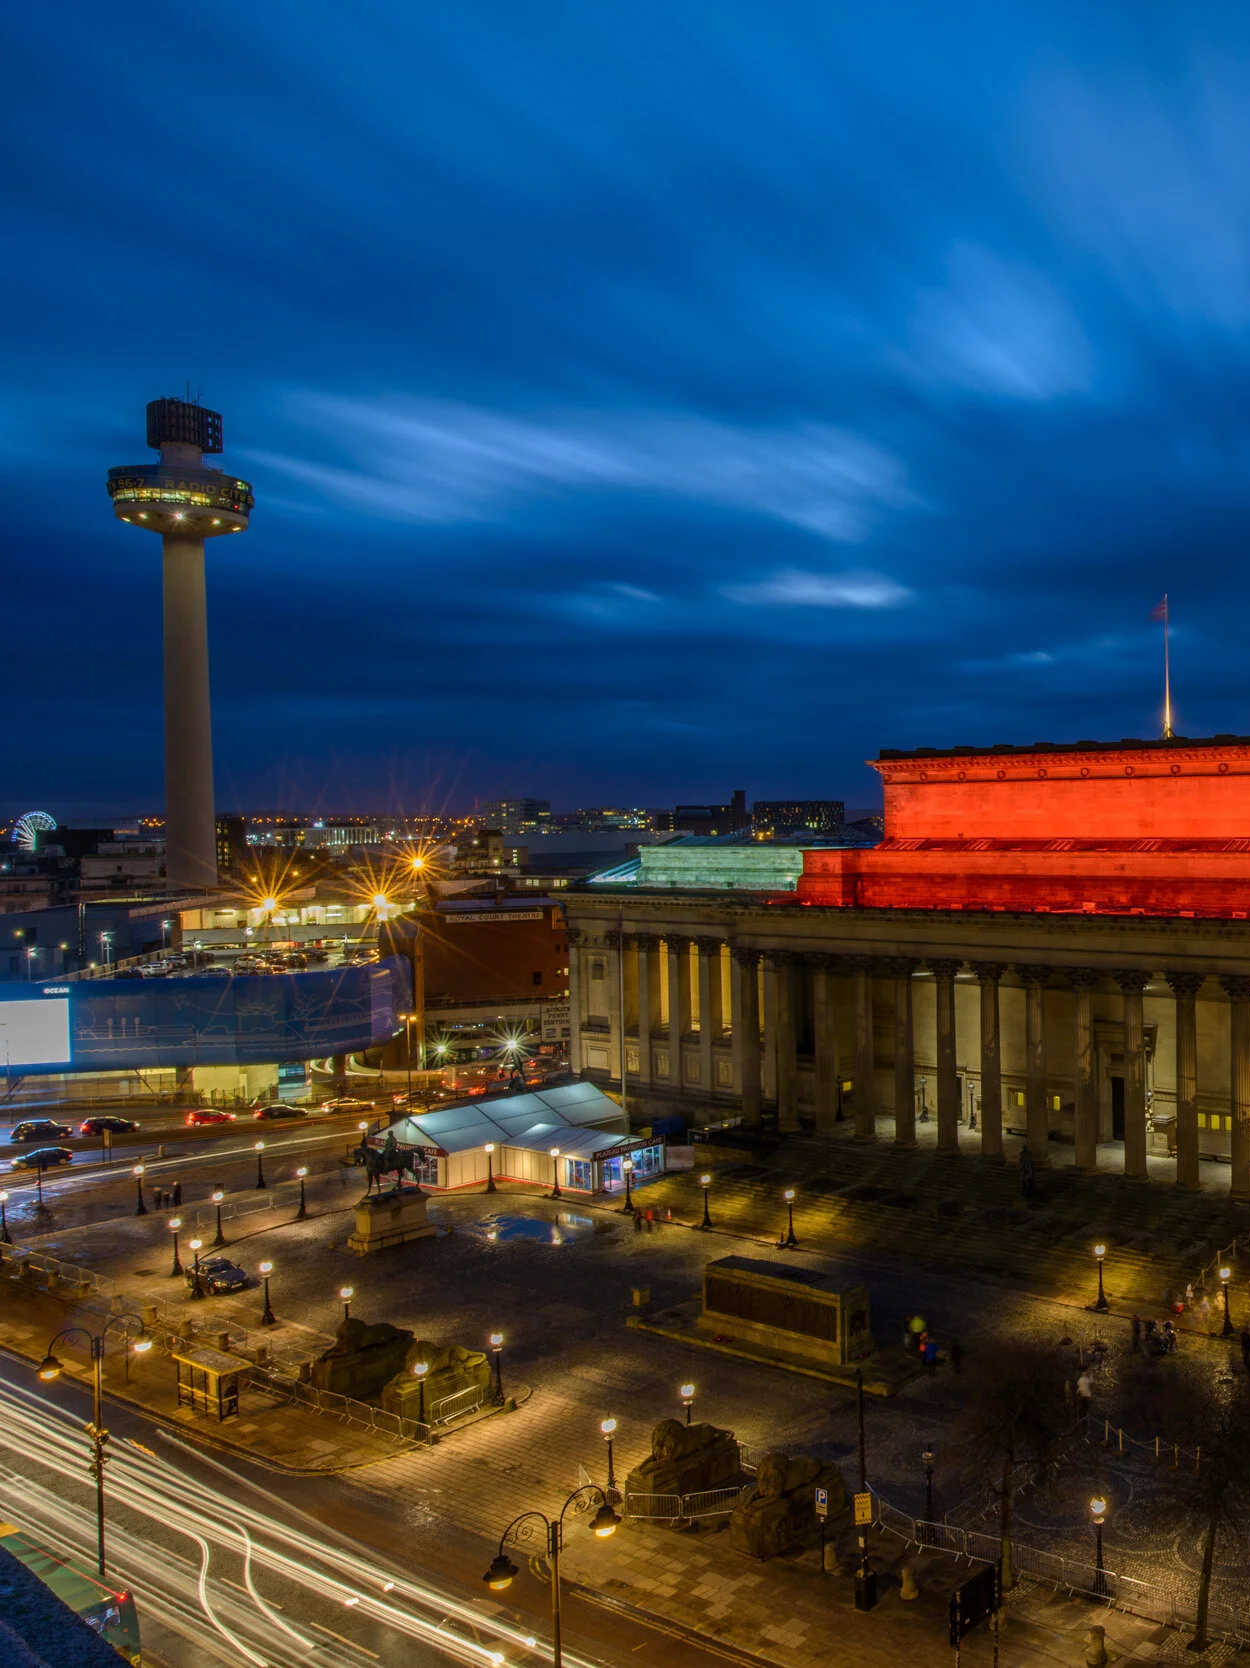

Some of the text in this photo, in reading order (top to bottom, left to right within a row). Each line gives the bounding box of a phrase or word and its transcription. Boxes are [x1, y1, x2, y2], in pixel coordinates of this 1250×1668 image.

[164, 479, 216, 494] RADIO
[220, 487, 245, 501] CITY
[507, 912, 541, 920] THEATRE
[596, 1148, 620, 1159] PLATEAU
[818, 1490, 826, 1503] P
